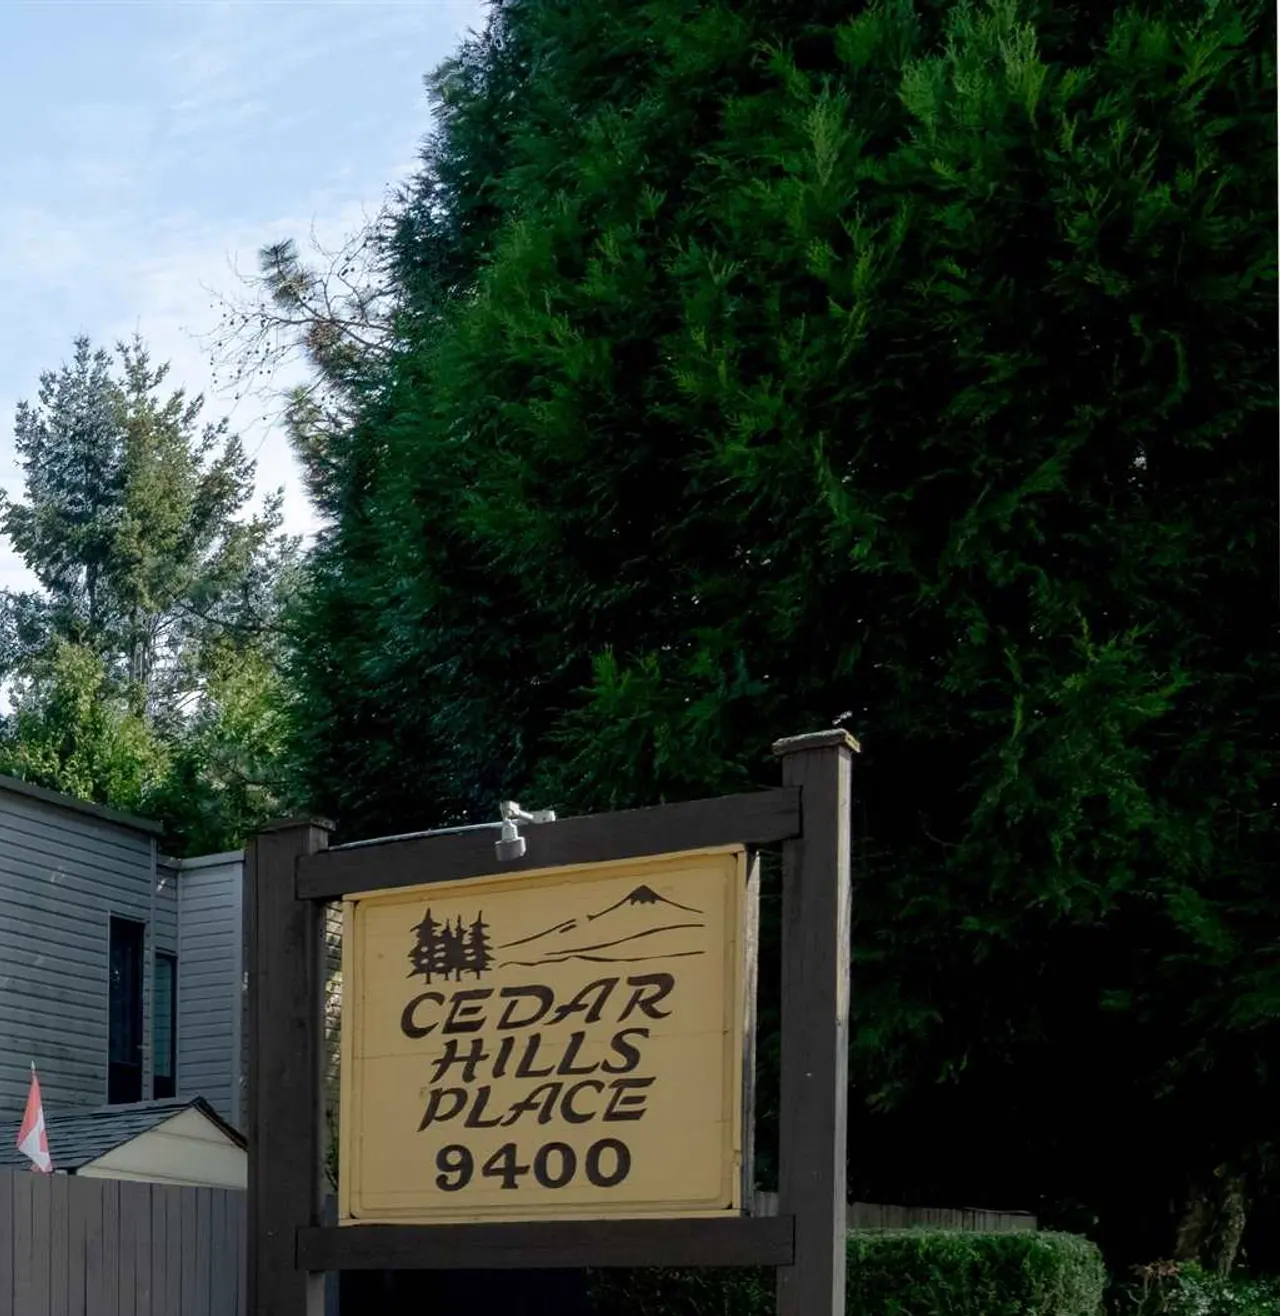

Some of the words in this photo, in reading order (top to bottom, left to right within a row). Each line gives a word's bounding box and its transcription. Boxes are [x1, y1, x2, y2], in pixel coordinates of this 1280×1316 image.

[400, 972, 675, 1040] CEDAR
[429, 1027, 650, 1085] HILLS
[417, 1076, 657, 1133] PLACE
[435, 1137, 632, 1192] 9400
